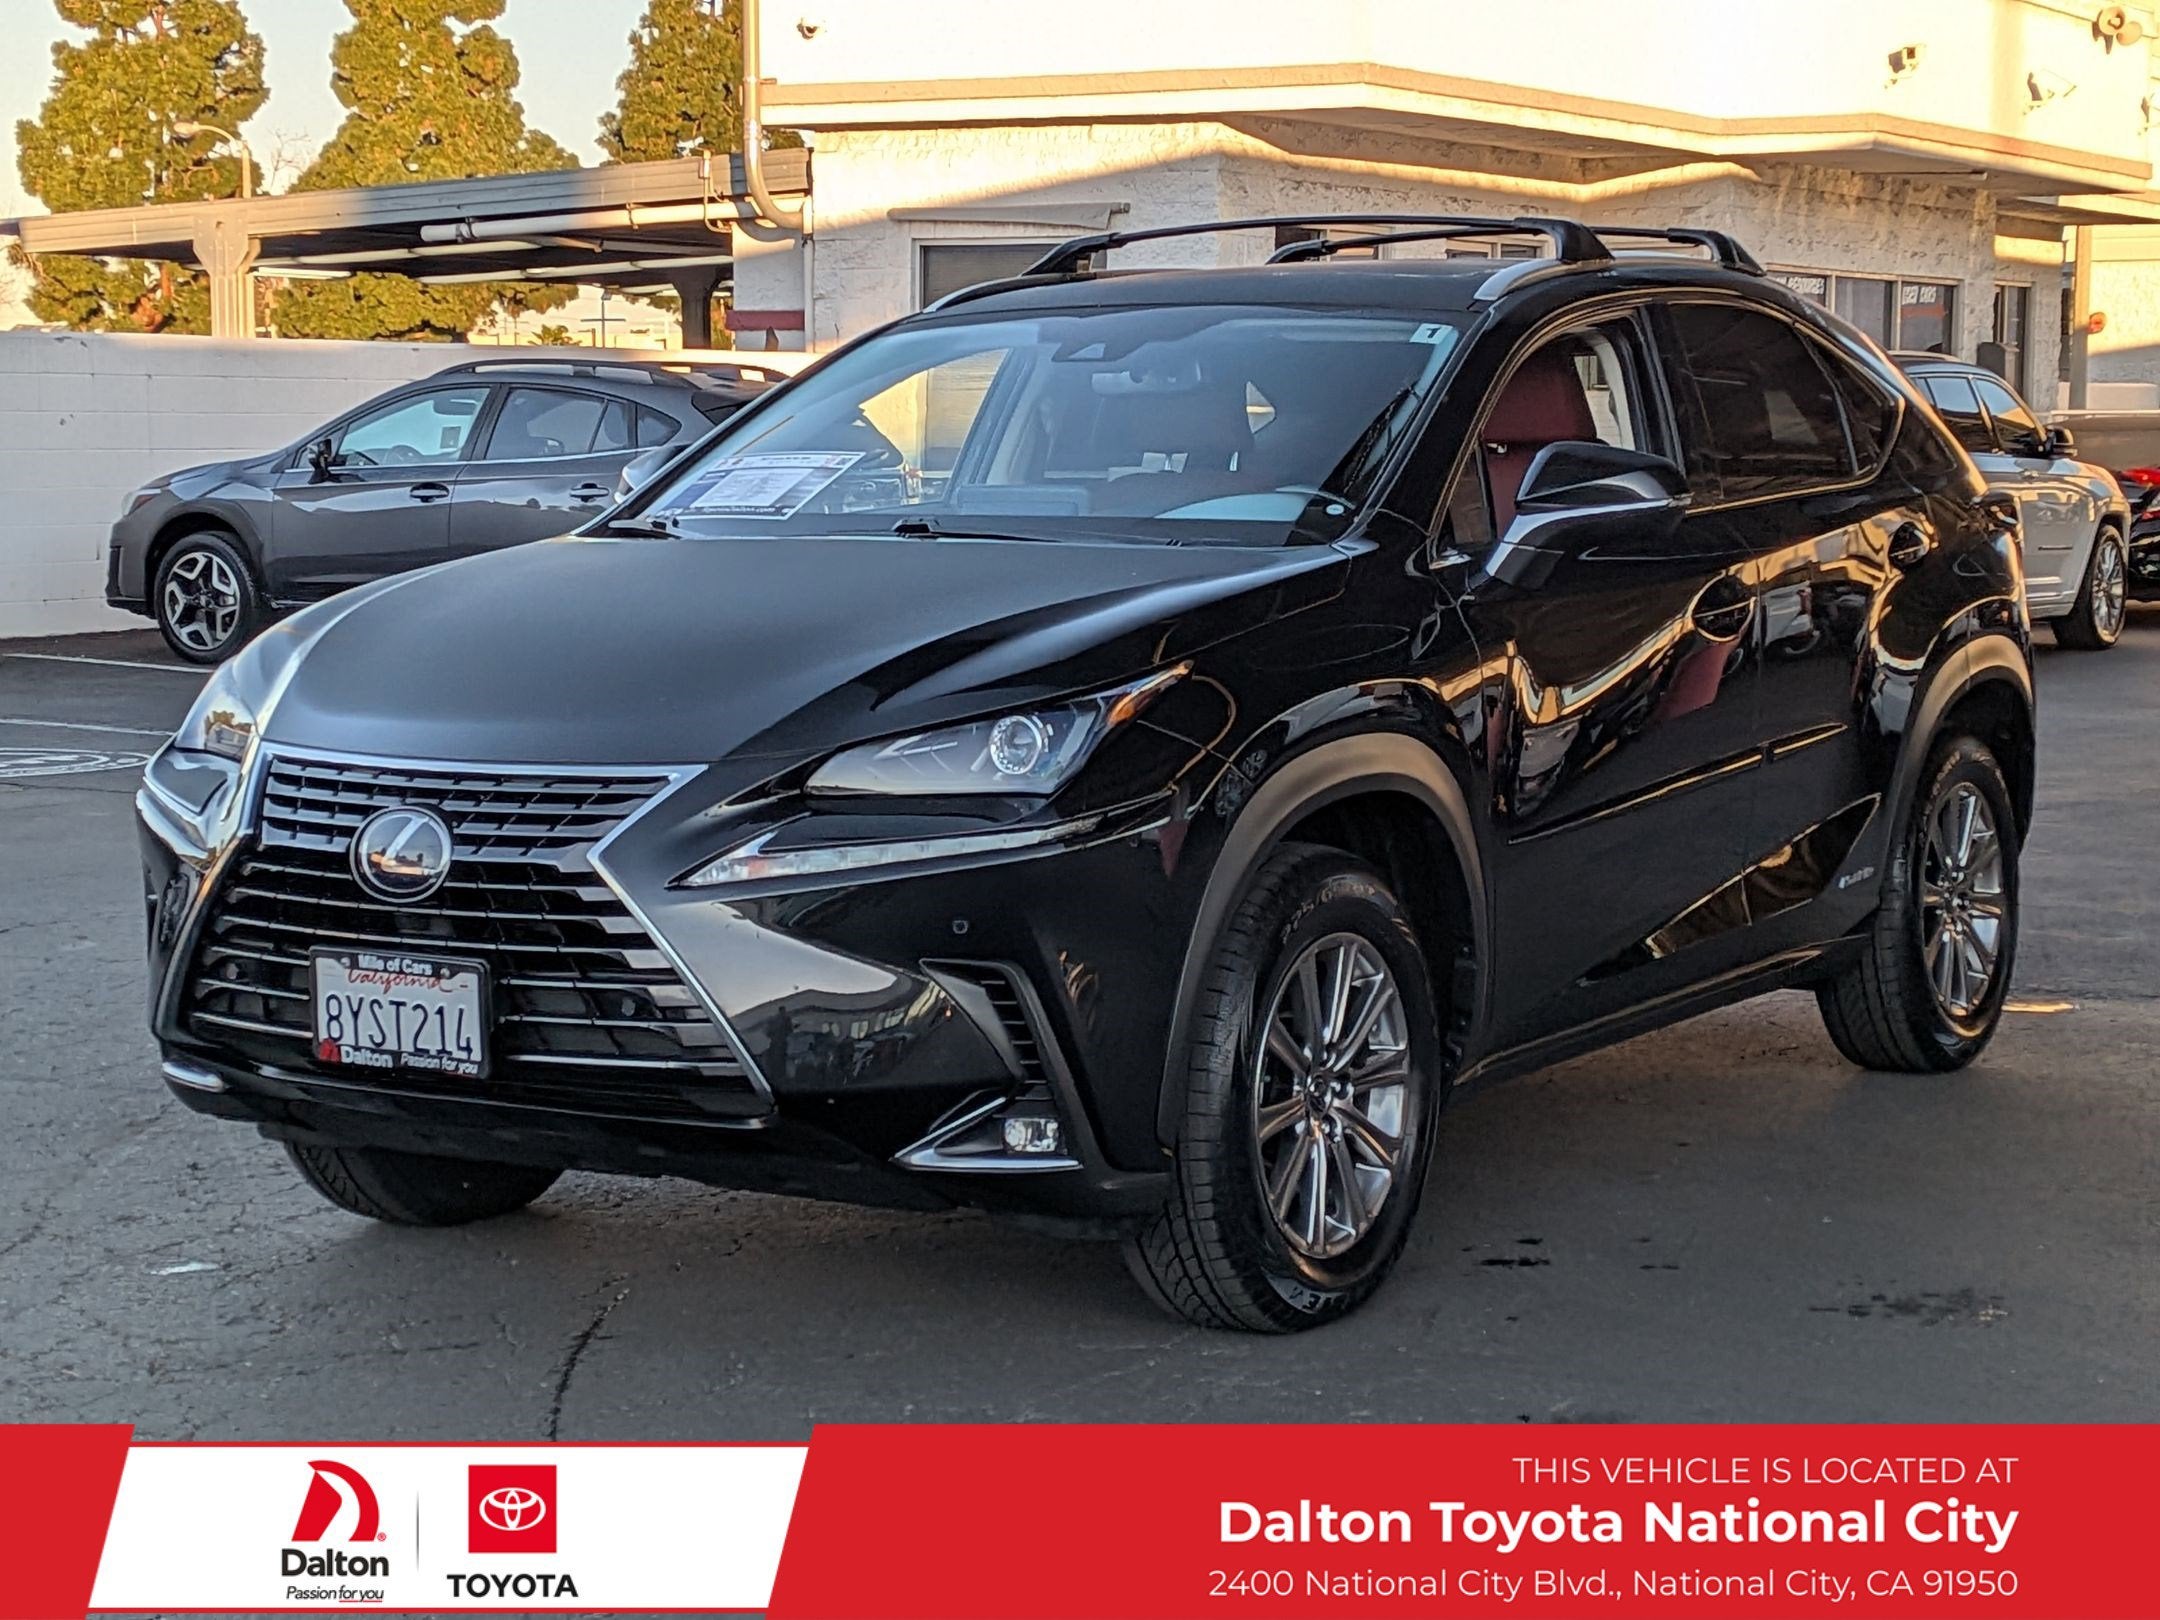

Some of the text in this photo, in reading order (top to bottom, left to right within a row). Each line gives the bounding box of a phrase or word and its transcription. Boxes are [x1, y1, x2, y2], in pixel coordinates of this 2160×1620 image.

[359, 955, 432, 975] Mile of Cars
[348, 969, 452, 994] California
[325, 993, 474, 1057] 8YST214
[340, 1046, 393, 1068] Dalton
[400, 1053, 479, 1074] Passion for you
